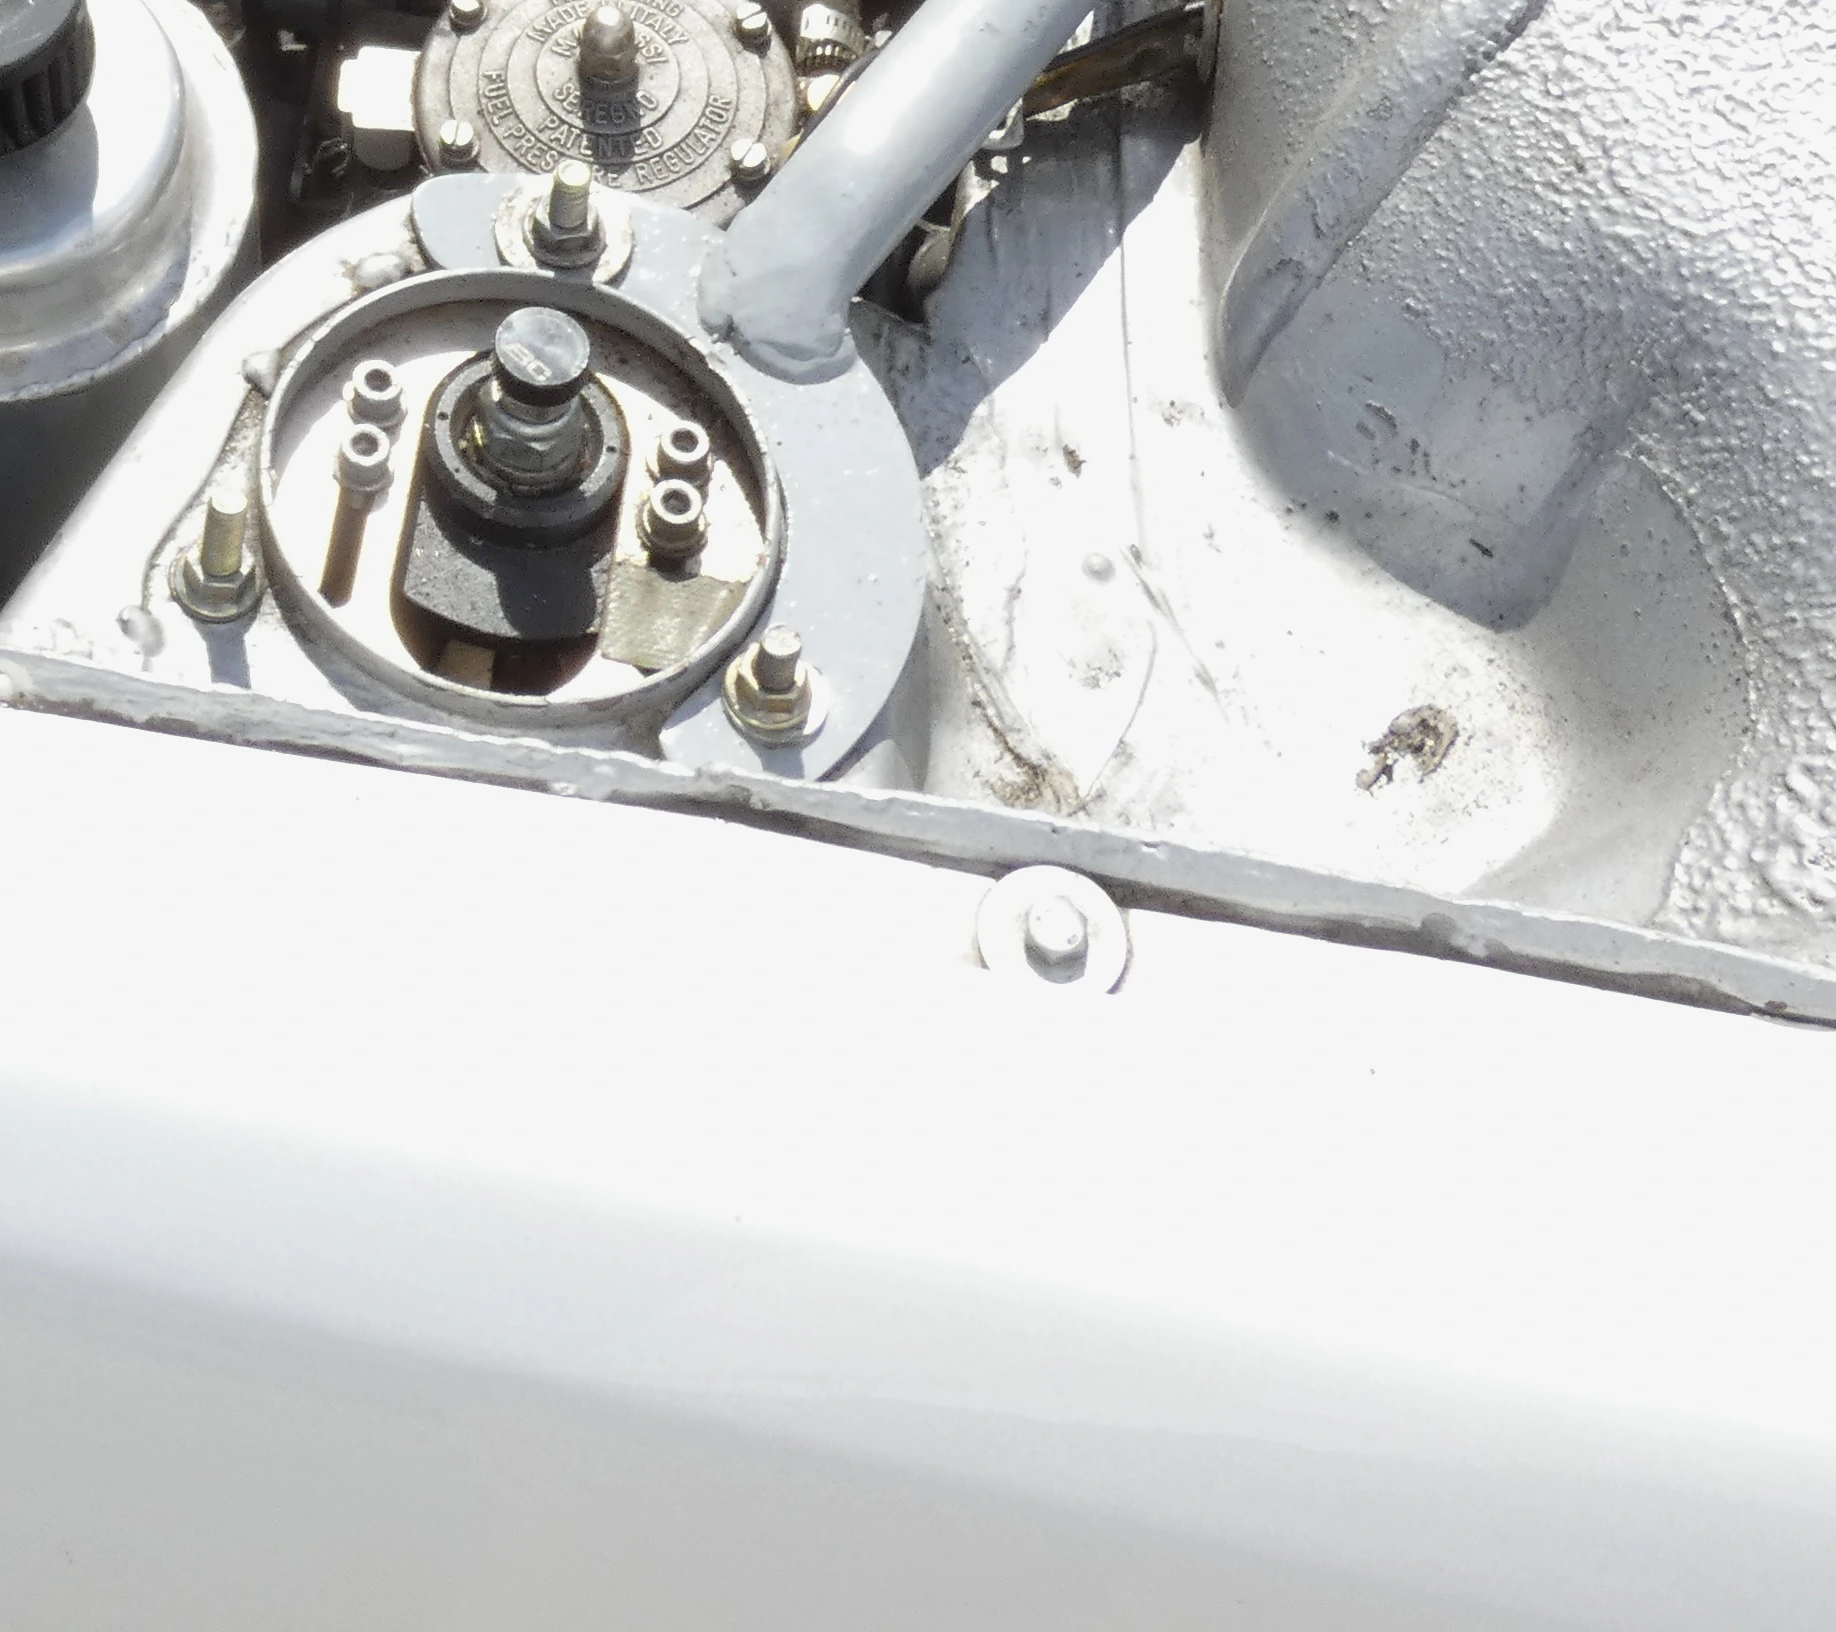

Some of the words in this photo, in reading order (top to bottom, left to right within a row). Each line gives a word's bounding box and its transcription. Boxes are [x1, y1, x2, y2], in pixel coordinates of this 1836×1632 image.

[526, 0, 590, 43] MADE
[630, 4, 689, 46] ITALY
[482, 69, 513, 125] FUEL
[504, 123, 622, 187] PRESRE
[636, 93, 733, 186] REGULATOR
[537, 115, 664, 155] PATENTED
